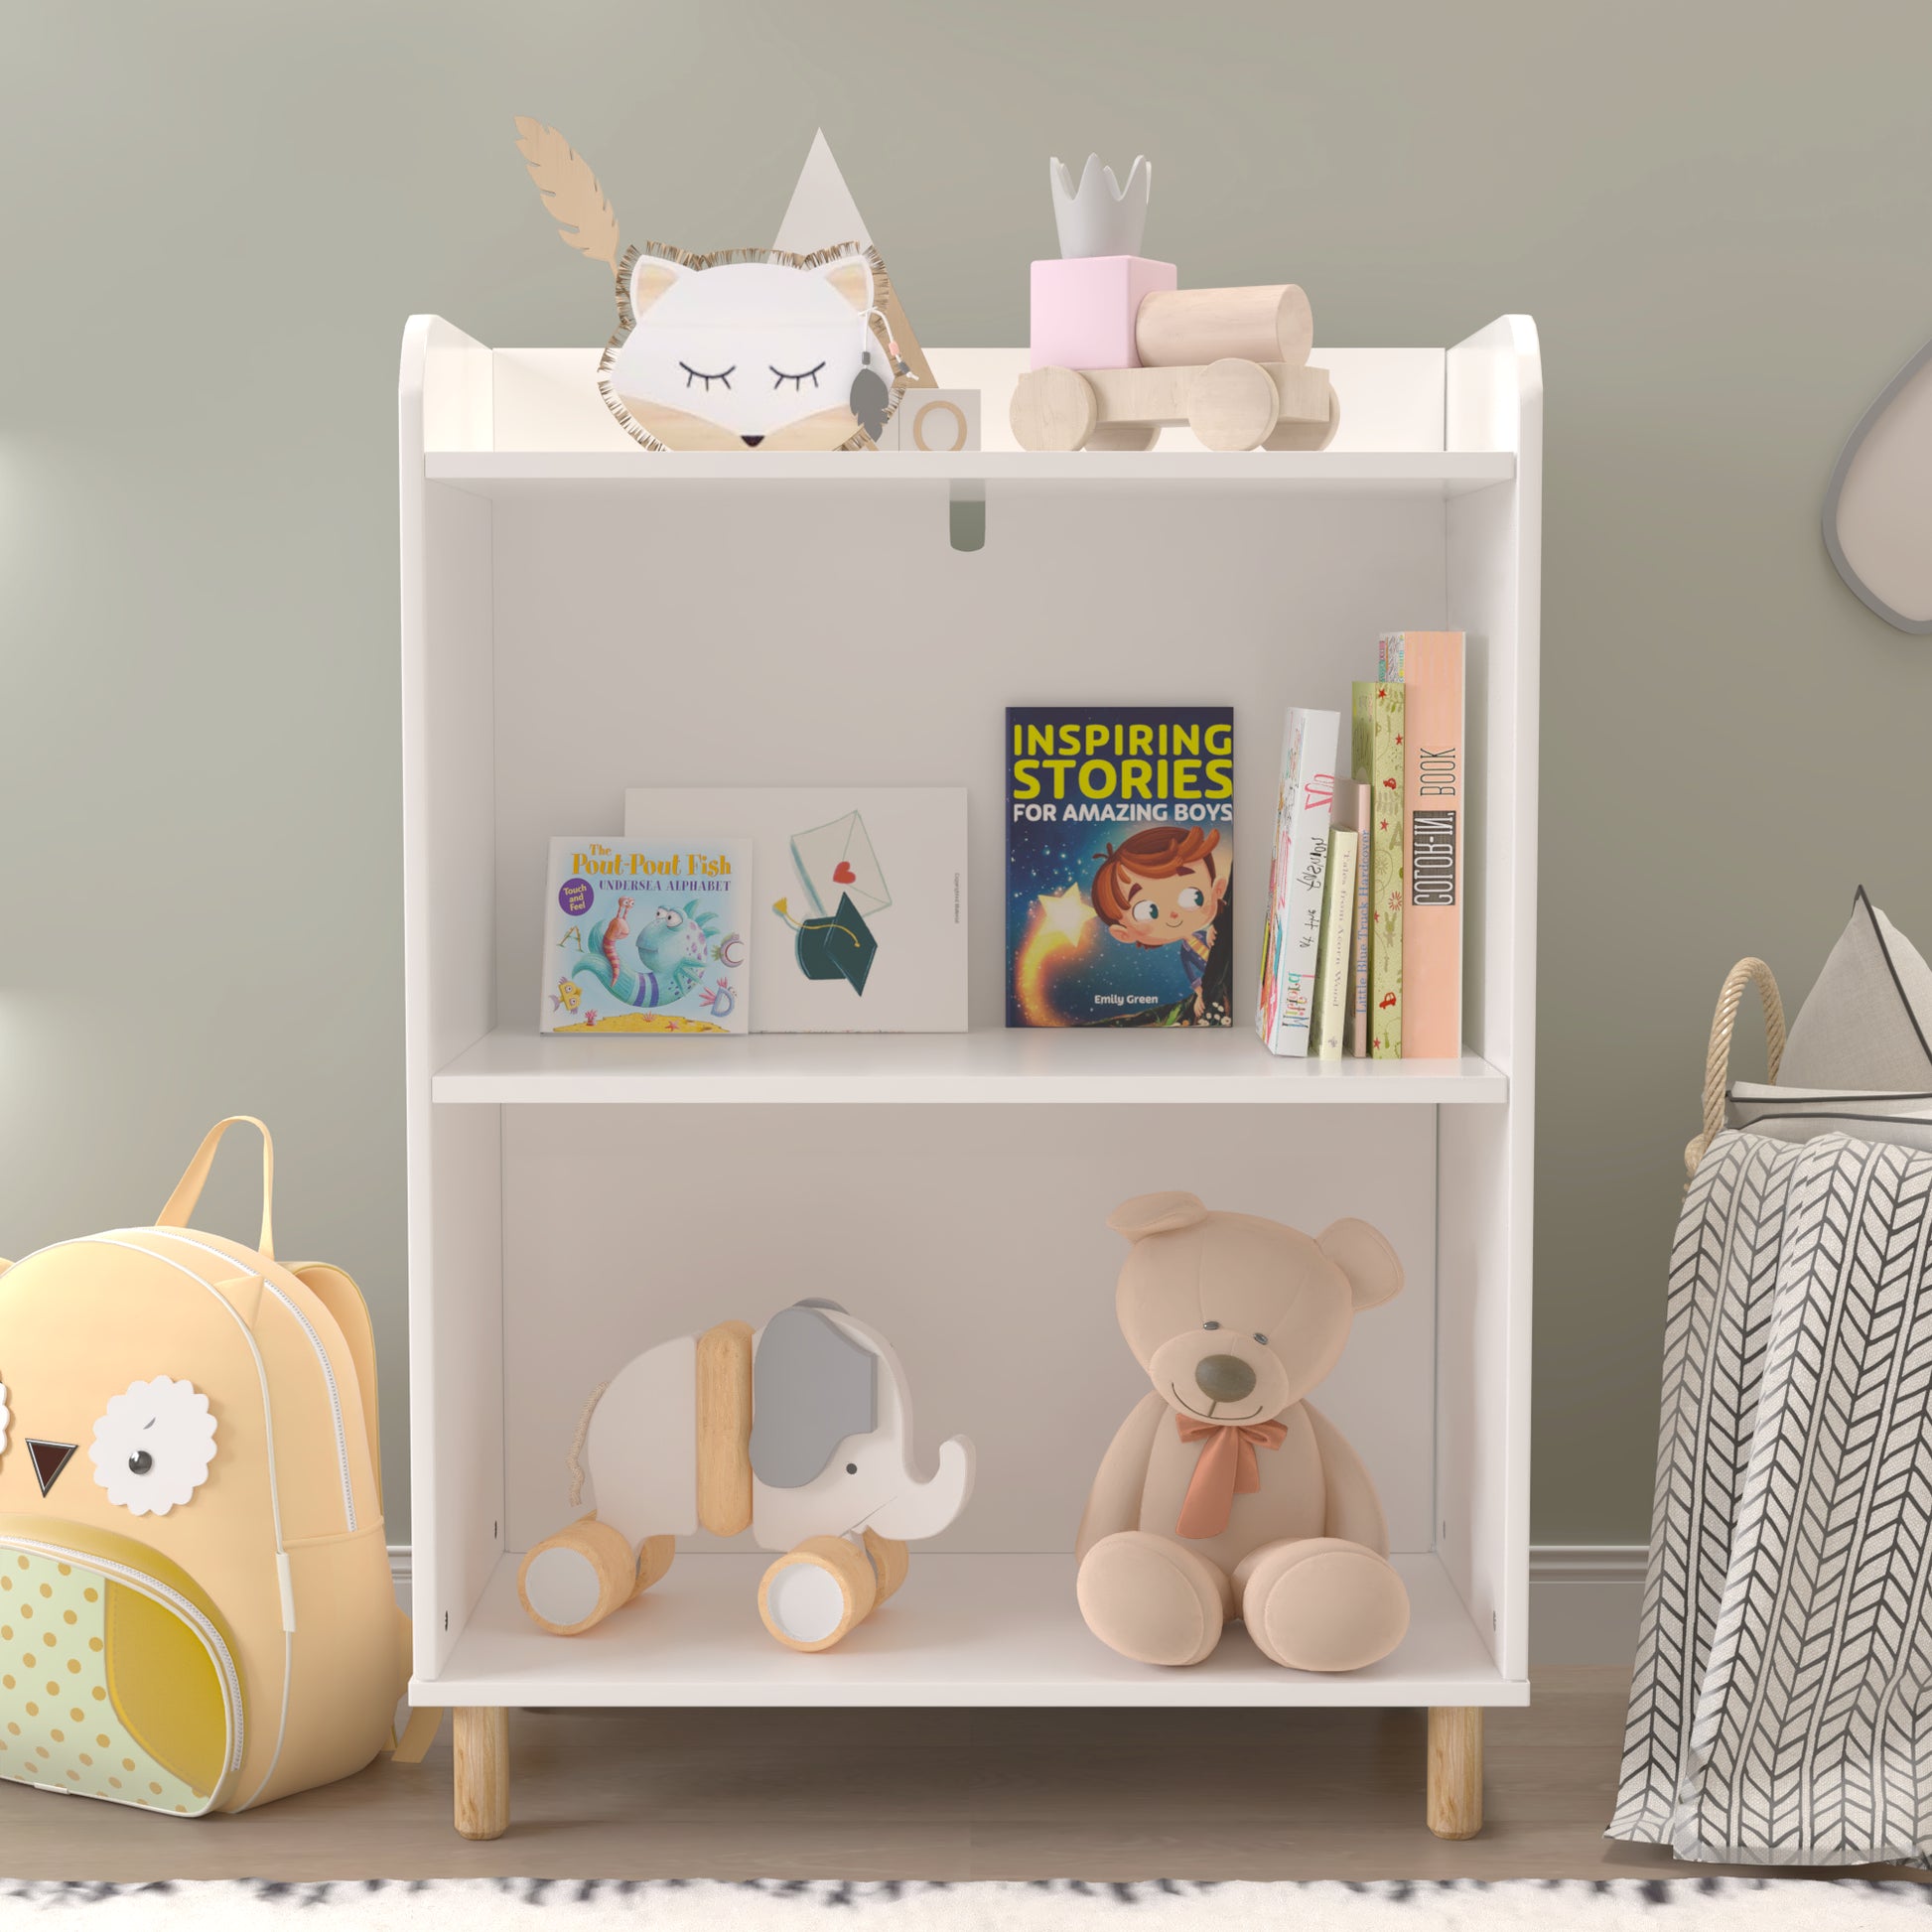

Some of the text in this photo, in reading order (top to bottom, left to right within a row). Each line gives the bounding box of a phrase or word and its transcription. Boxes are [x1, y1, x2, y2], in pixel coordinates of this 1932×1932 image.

[1014, 724, 1232, 756] INSPIRING
[1013, 759, 1233, 800] STORIES
[1014, 803, 1233, 823] FOR AMAZING BOYS
[590, 844, 612, 856] The
[571, 853, 733, 878] Pout-Pout Fish
[563, 885, 587, 897] Touch
[599, 880, 732, 892] UNDERSEA ALPHABET
[569, 894, 585, 902] and
[570, 900, 587, 912] Feel
[1355, 830, 1370, 1013] Little Blue Truck Hardcover
[1094, 994, 1159, 1006] Emily Green
